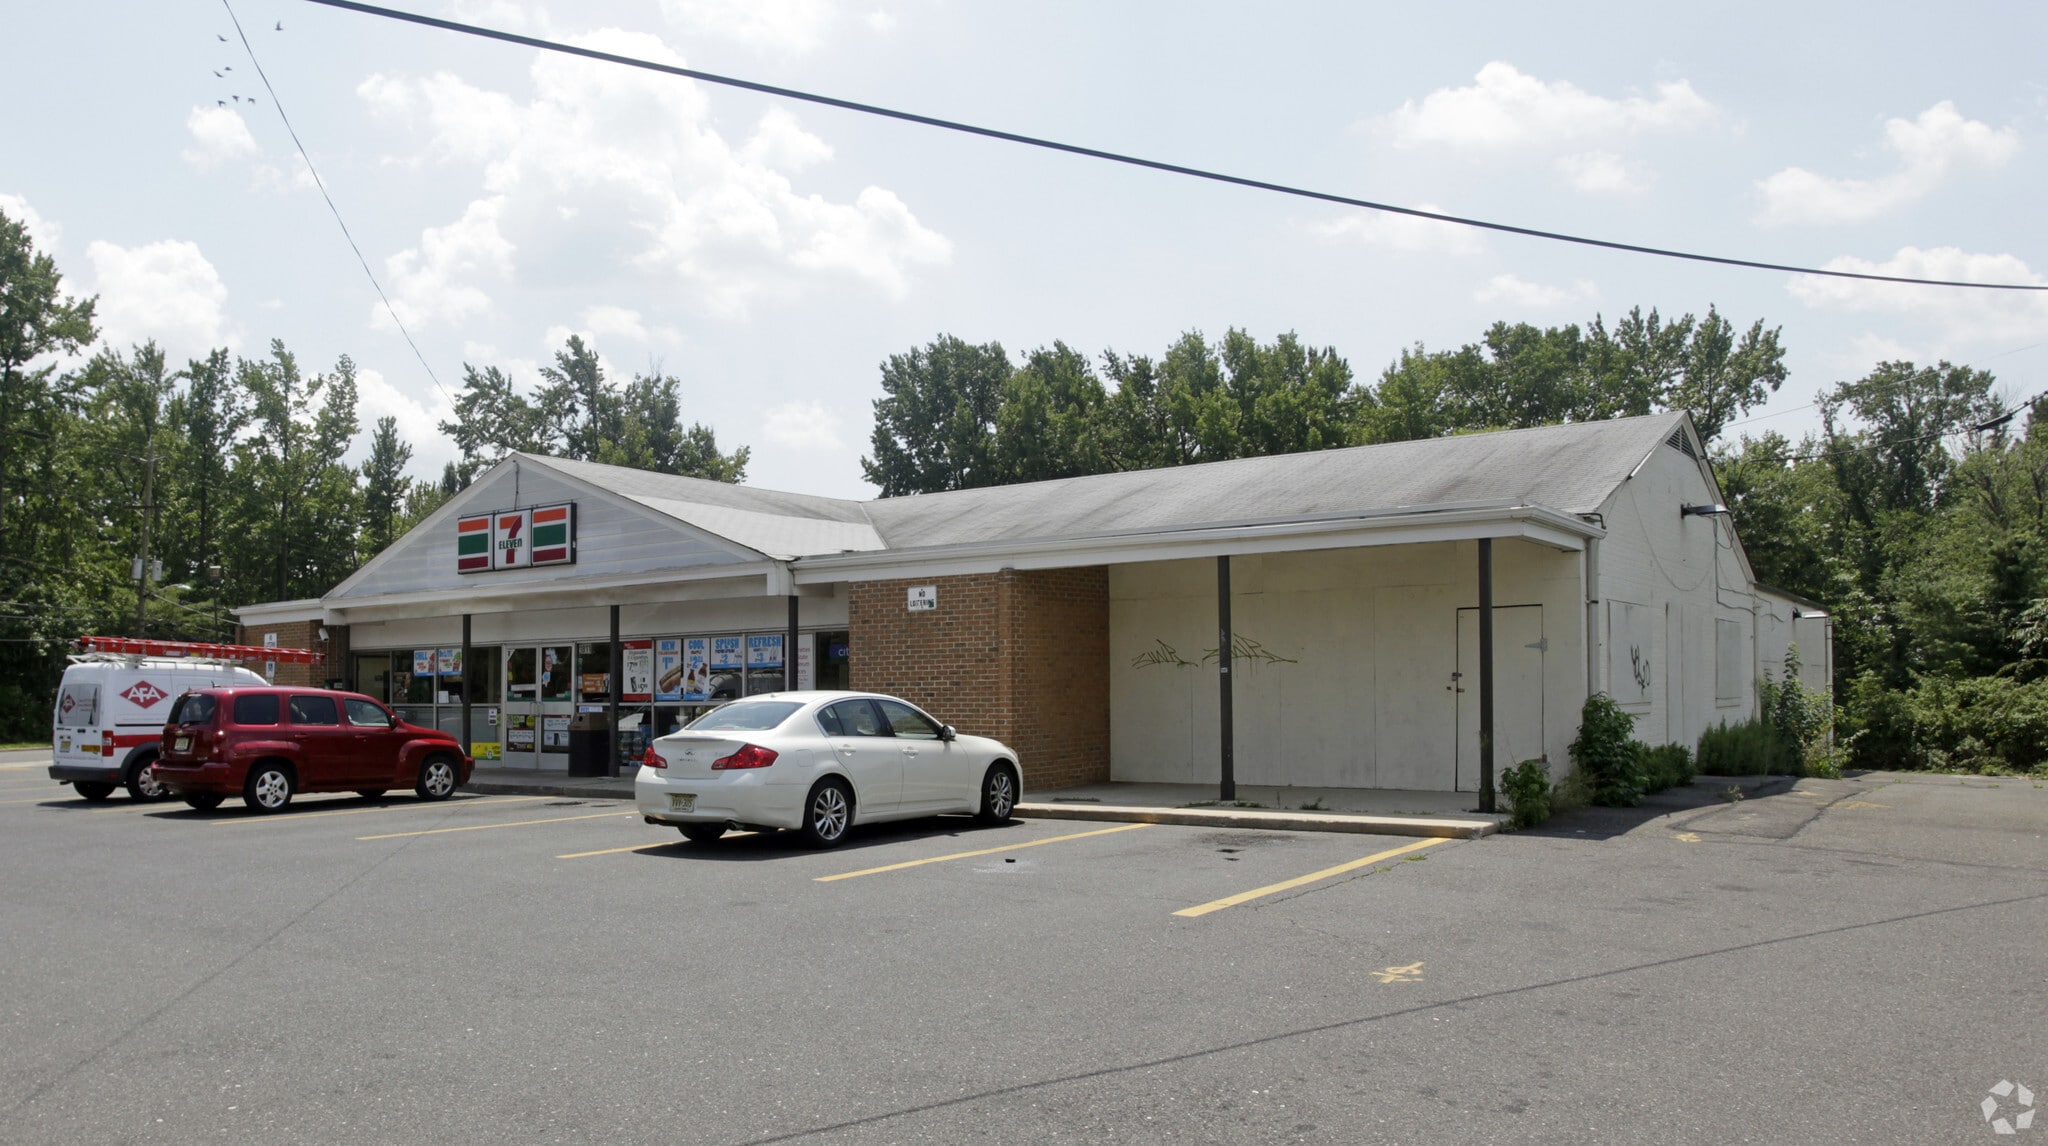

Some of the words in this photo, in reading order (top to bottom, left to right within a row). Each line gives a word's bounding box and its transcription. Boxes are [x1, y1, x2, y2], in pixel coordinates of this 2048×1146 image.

[499, 515, 522, 564] 7
[748, 635, 782, 648] REFRESH
[838, 647, 849, 657] cit
[127, 685, 162, 703] AFA
